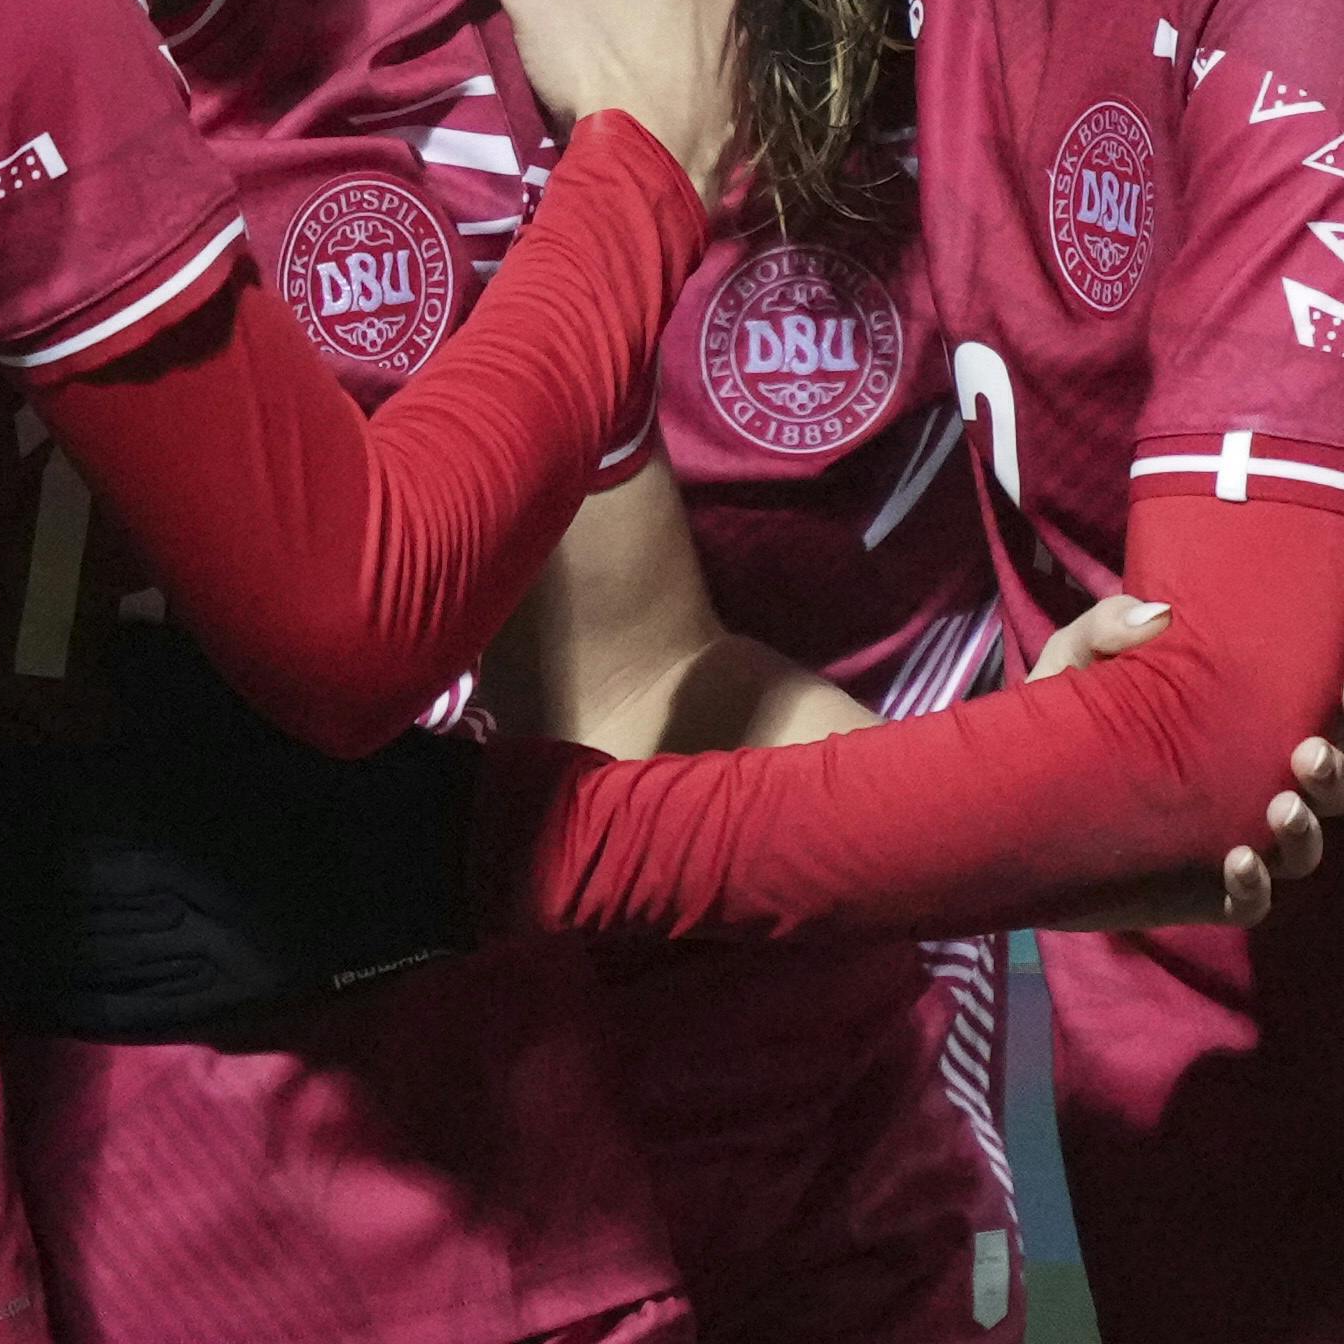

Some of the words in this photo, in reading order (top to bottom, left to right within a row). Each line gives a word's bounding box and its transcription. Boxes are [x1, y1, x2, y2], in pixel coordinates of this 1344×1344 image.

[1056, 152, 1080, 270] DANSK
[1083, 274, 1123, 304] 1889
[1077, 169, 1140, 236] DBU
[304, 190, 419, 242] BOLDSPIL
[414, 239, 444, 349] UNION
[317, 250, 415, 316] DBU
[710, 307, 754, 425] DANSK
[743, 315, 859, 375] DBU
[854, 310, 895, 419] UNION
[766, 418, 843, 445] 1889
